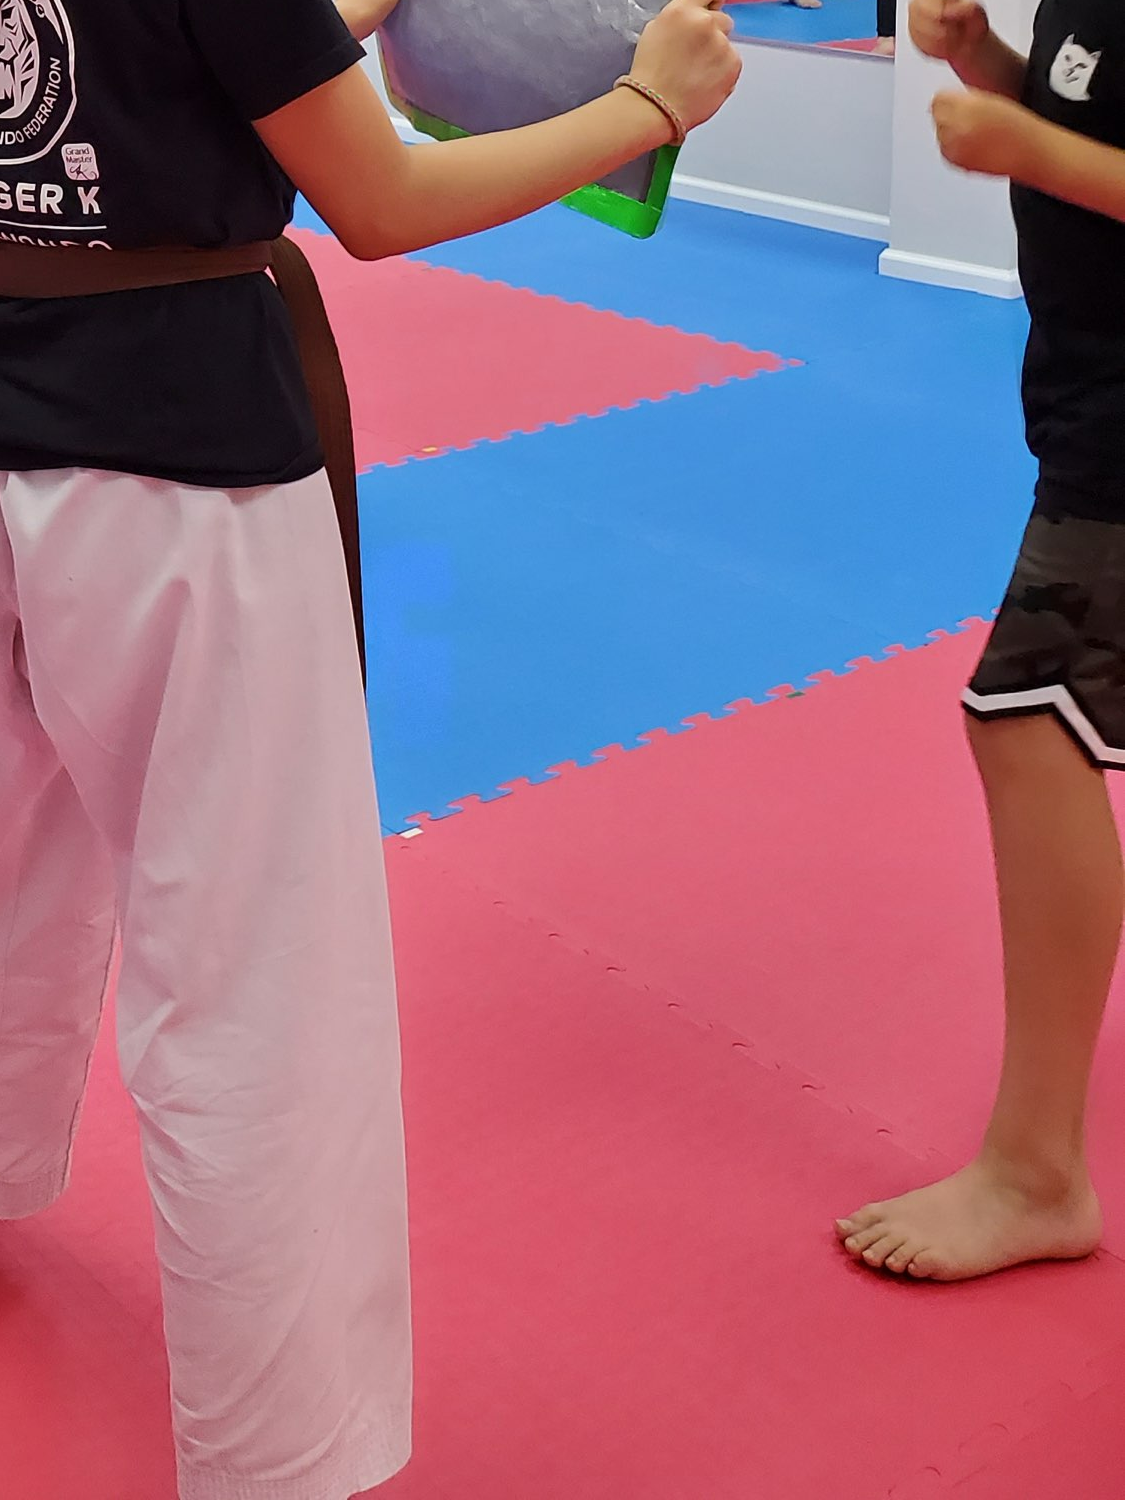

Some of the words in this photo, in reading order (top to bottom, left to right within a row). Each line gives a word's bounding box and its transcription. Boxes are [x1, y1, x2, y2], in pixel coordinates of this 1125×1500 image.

[22, 57, 62, 140] FEDERATION
[65, 147, 89, 155] Grand
[77, 186, 102, 214] K
